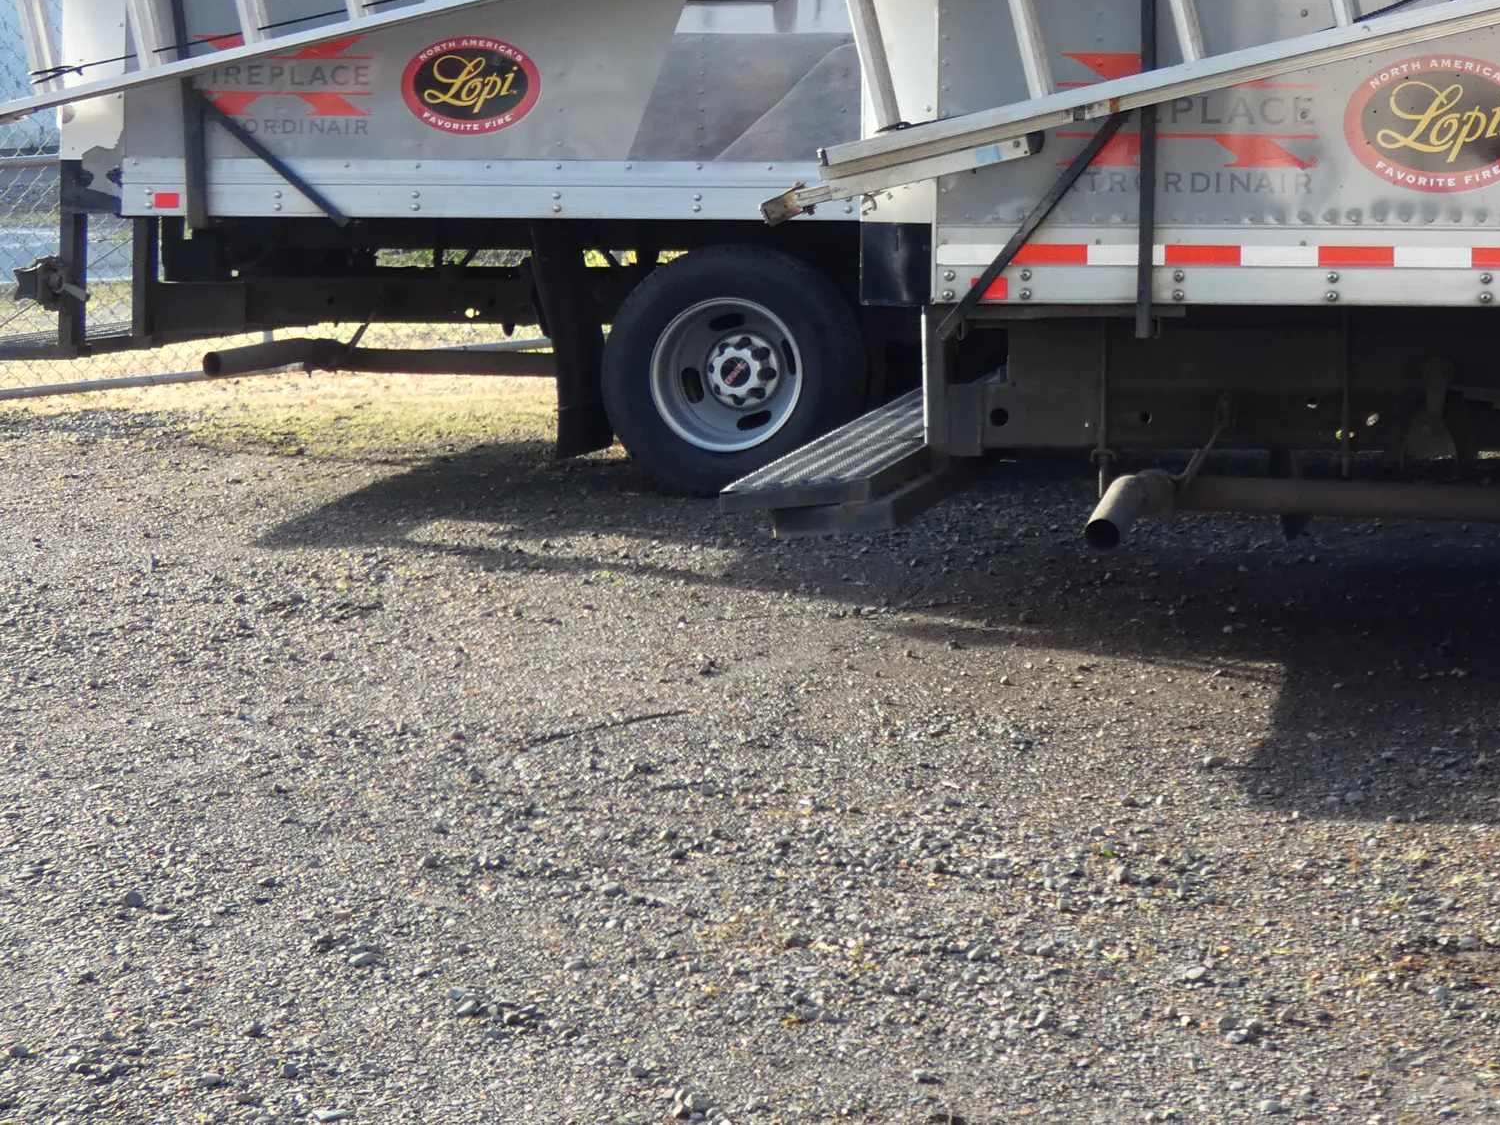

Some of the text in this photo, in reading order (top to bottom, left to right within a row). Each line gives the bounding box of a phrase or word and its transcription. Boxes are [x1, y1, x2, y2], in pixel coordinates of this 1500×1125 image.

[418, 38, 523, 63] NORTH AMERICA'S
[423, 54, 519, 114] Lopi
[1368, 60, 1422, 90] NORTH
[422, 111, 513, 131] FAVORITE FIRE
[1152, 96, 1316, 126] PLACE
[1375, 160, 1457, 187] FAVORITE
